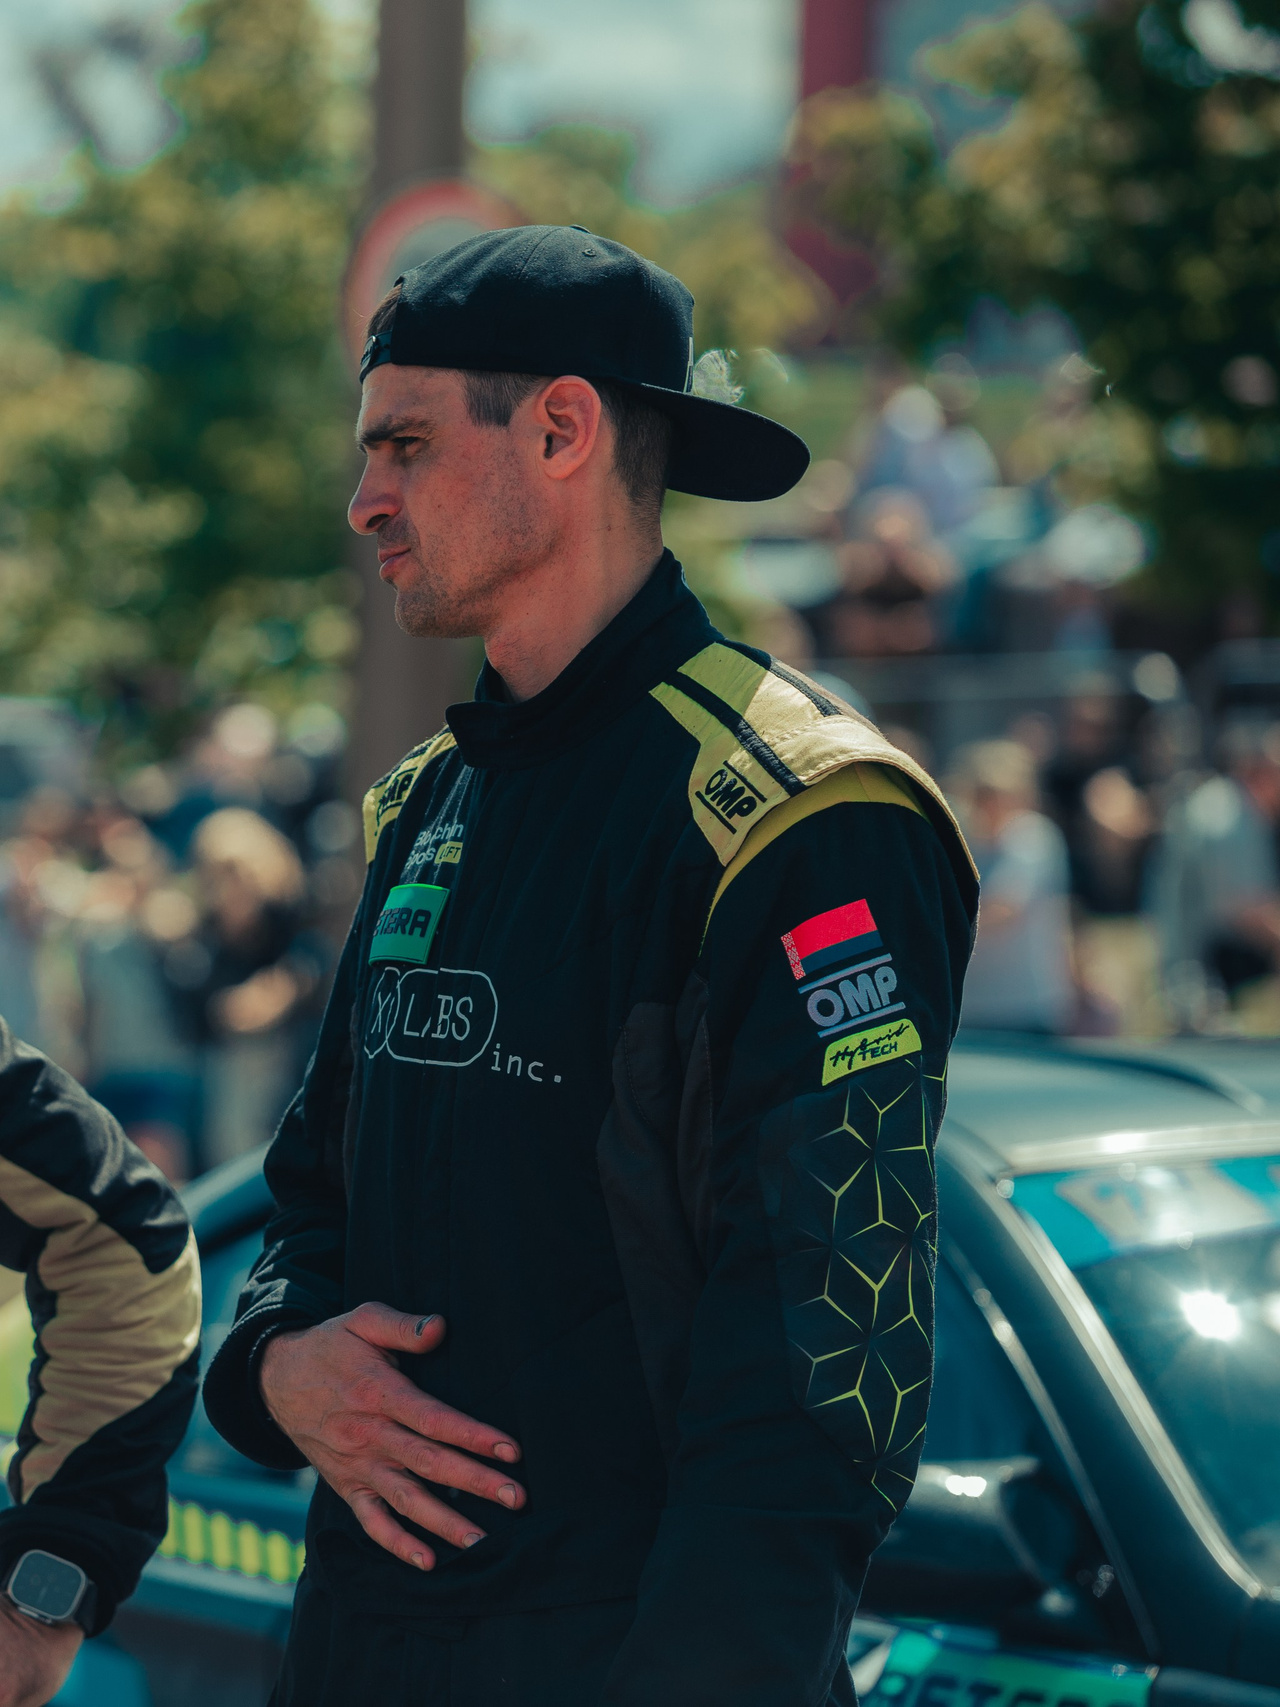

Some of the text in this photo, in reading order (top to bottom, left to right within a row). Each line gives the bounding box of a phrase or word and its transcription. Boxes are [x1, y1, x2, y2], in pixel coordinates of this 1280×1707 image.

[704, 768, 758, 820] OMP
[807, 965, 898, 1027] OMP
[491, 1043, 562, 1083] inc.
[829, 1023, 910, 1071] Hybrid
[858, 1041, 899, 1061] TECH
